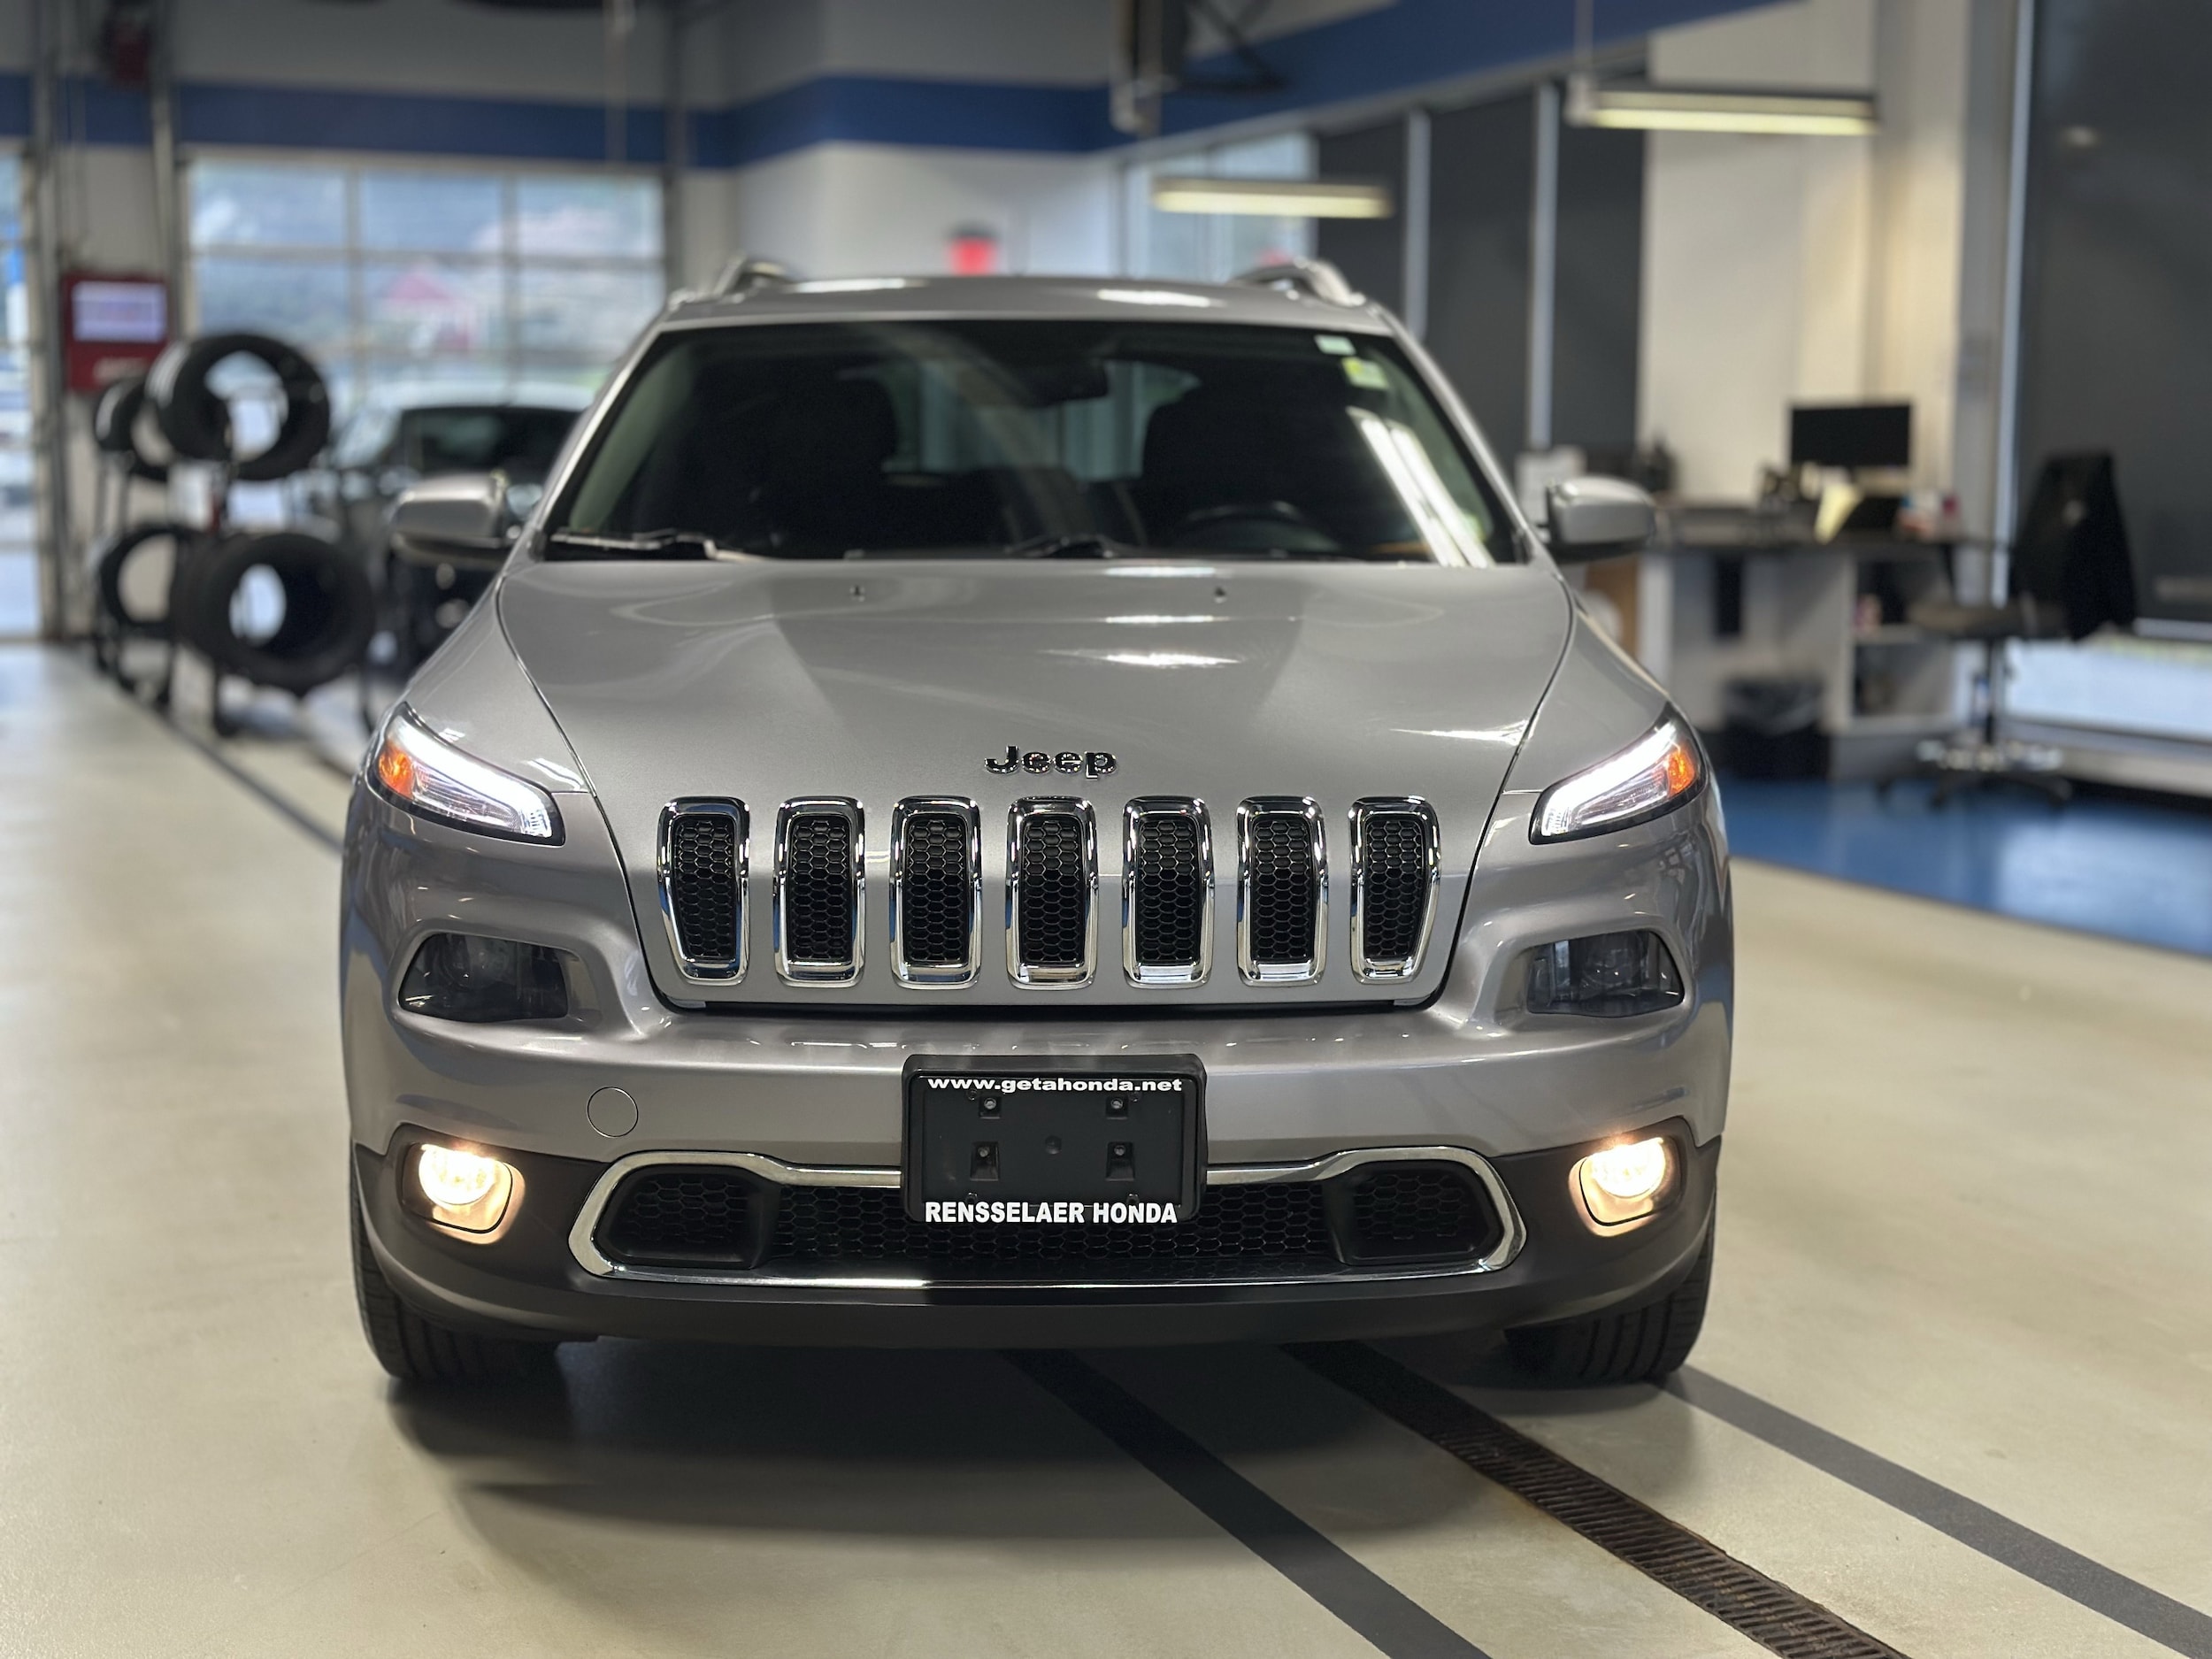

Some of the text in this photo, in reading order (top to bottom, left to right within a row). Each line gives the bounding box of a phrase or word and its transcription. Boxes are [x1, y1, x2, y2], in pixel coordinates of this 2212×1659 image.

[984, 745, 1118, 780] Jeep
[927, 1078, 1183, 1094] www.getahonda.net
[925, 1202, 1178, 1224] RENSSELAER HONDA
